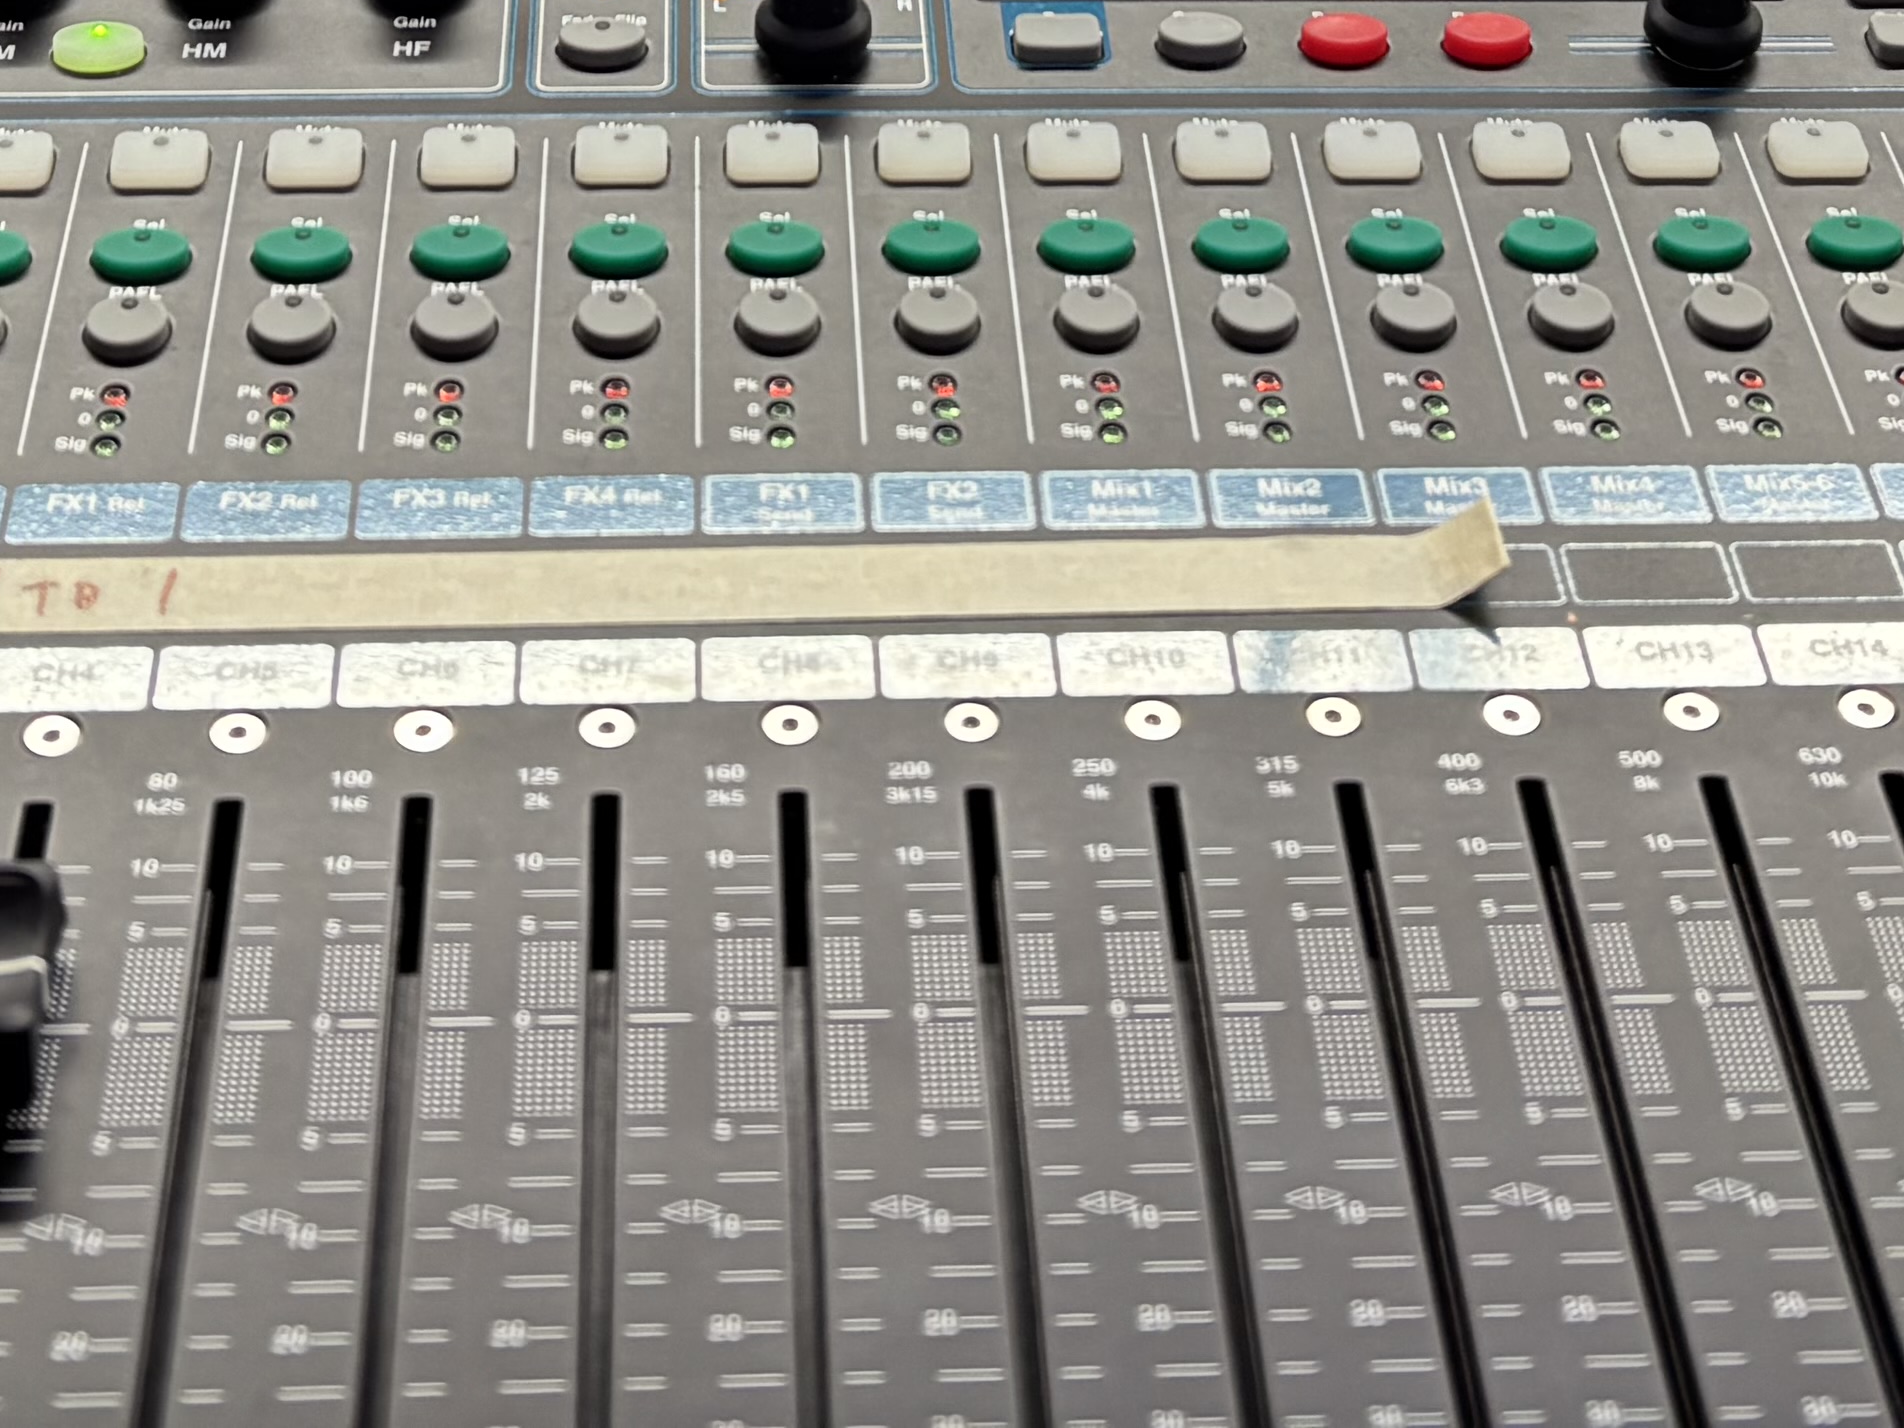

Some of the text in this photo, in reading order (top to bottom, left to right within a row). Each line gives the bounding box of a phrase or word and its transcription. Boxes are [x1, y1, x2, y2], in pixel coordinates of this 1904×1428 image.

[713, 0, 728, 13] L
[187, 18, 231, 31] Gain
[393, 16, 437, 29] Gain
[181, 42, 227, 59] HM
[392, 40, 431, 57] HF
[760, 483, 809, 502] FX1
[926, 481, 980, 501] FX2
[1091, 479, 1153, 500] Mix1
[1257, 477, 1322, 498] Mix2
[1424, 476, 1490, 497] Mix3
[1589, 473, 1656, 494] Mix4
[46, 493, 98, 514] FX1
[219, 491, 273, 510] FX2
[392, 488, 447, 508] FX3
[564, 486, 618, 506] FX4
[1634, 639, 1715, 664] CH13
[1808, 637, 1890, 660] CH14
[1256, 755, 1300, 774] 315
[1437, 752, 1482, 771] 400
[1618, 749, 1662, 768] 500
[1798, 746, 1842, 765] 630
[518, 766, 560, 786] 125
[706, 763, 746, 782] 160
[888, 760, 932, 780] 200
[1072, 757, 1117, 777] 250
[332, 769, 373, 788] 100
[1445, 777, 1485, 795] 6k3
[1810, 771, 1847, 788] 10k
[706, 789, 745, 807] 2k5
[886, 786, 937, 804] 3k15
[1082, 783, 1110, 800] 4k
[1267, 780, 1294, 798] 5k
[134, 798, 185, 816] 1k25
[331, 795, 369, 812] 1k6
[524, 792, 551, 810] 2k
